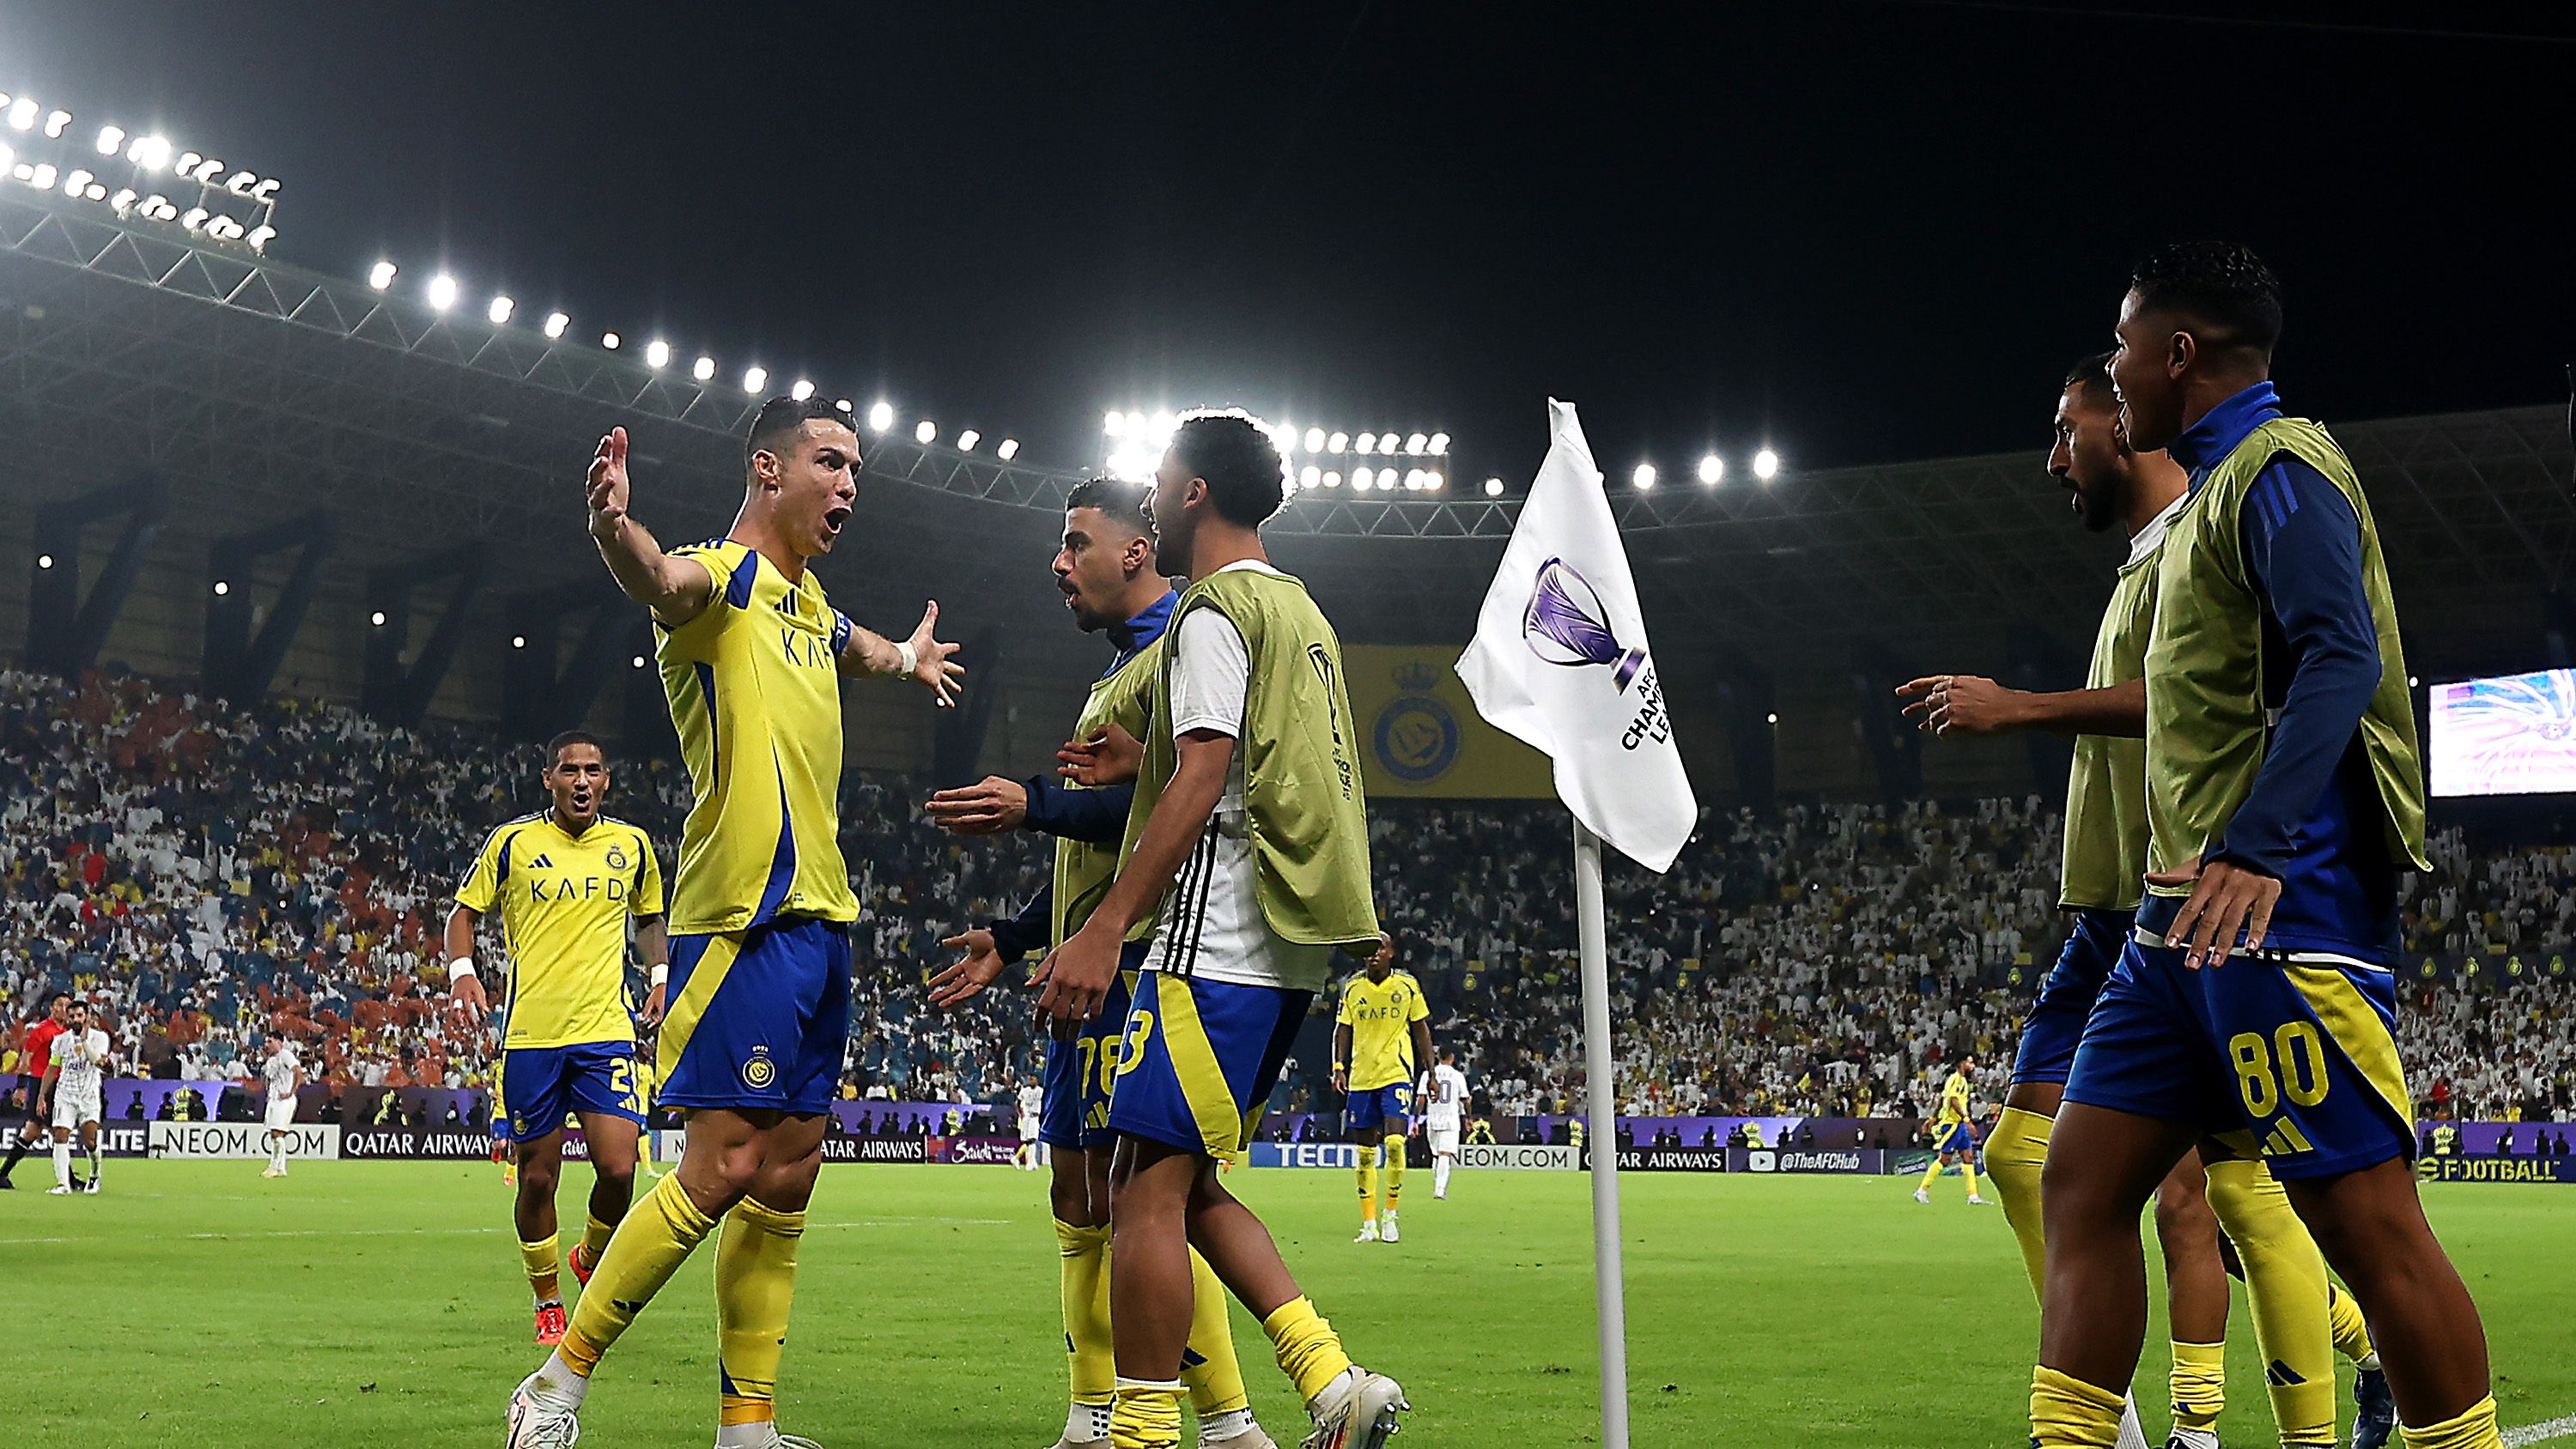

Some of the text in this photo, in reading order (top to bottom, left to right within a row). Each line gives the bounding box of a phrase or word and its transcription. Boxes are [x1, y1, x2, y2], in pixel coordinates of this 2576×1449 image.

[1637, 667, 1655, 699] AFC
[530, 876, 625, 902] KAFD
[1358, 1006, 1401, 1022] KAFD
[2229, 1021, 2330, 1117] 80
[346, 1133, 493, 1155] QATAR AIRWAY
[821, 1139, 921, 1159] ATAR AIRWAYS
[1648, 1152, 1721, 1168] AIRWAYS
[1780, 1152, 1860, 1171] @TheAFCHub
